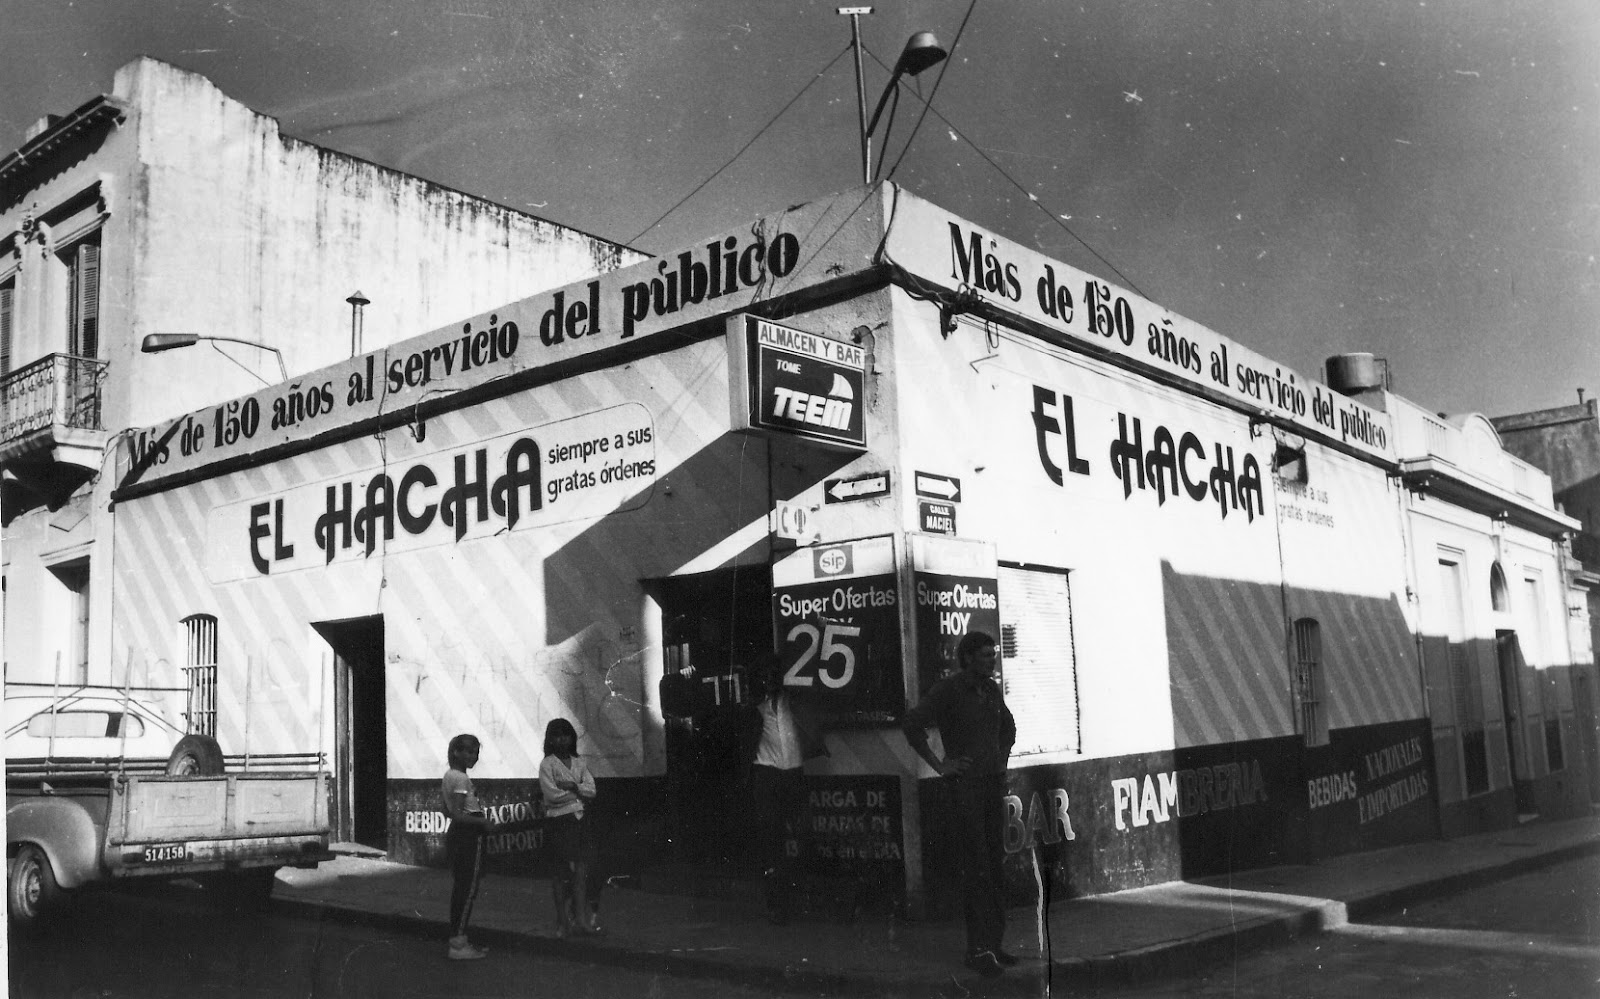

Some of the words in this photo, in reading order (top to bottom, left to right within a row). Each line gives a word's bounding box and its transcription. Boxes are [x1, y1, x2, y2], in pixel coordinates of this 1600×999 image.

[127, 426, 171, 472] Más
[180, 416, 204, 457] de
[213, 397, 260, 448] 150
[271, 380, 334, 430] años
[347, 355, 374, 406] al
[387, 313, 520, 394] servicio
[540, 280, 601, 347] del
[620, 233, 800, 339] público
[760, 324, 817, 354] ALMACEN
[822, 340, 831, 358] Y
[836, 344, 861, 366] BAR
[948, 221, 1022, 302] Más
[1037, 264, 1074, 324] de
[1083, 280, 1135, 346] 150
[1147, 317, 1202, 375] años
[1211, 343, 1230, 387] al
[1236, 367, 1306, 417] servicio
[1312, 386, 1336, 430] del
[1339, 404, 1387, 450] público
[776, 359, 802, 375] TOME
[773, 386, 853, 431] TEEM
[548, 437, 609, 464] siempre
[613, 433, 625, 450] a
[627, 427, 652, 447] sus
[1030, 384, 1091, 488] EL
[1110, 411, 1264, 525] HACHA
[547, 469, 597, 503] gratas
[600, 458, 656, 484] órdenes
[249, 498, 294, 575] EL
[314, 437, 543, 567] HACHA
[926, 515, 954, 531] MACIEL
[929, 504, 951, 515] CALLE
[821, 551, 846, 570] sip
[780, 593, 830, 620] Super
[832, 586, 896, 612] Ofertas
[917, 581, 953, 611] Super
[953, 583, 997, 610] Ofertas
[940, 611, 972, 636] HOY
[783, 623, 861, 689] 25
[808, 790, 858, 808] ARGA
[1308, 770, 1357, 809] BEBIDAS
[405, 811, 451, 833] BEBID
[481, 801, 537, 825] NACION
[1002, 788, 1076, 854] BAR
